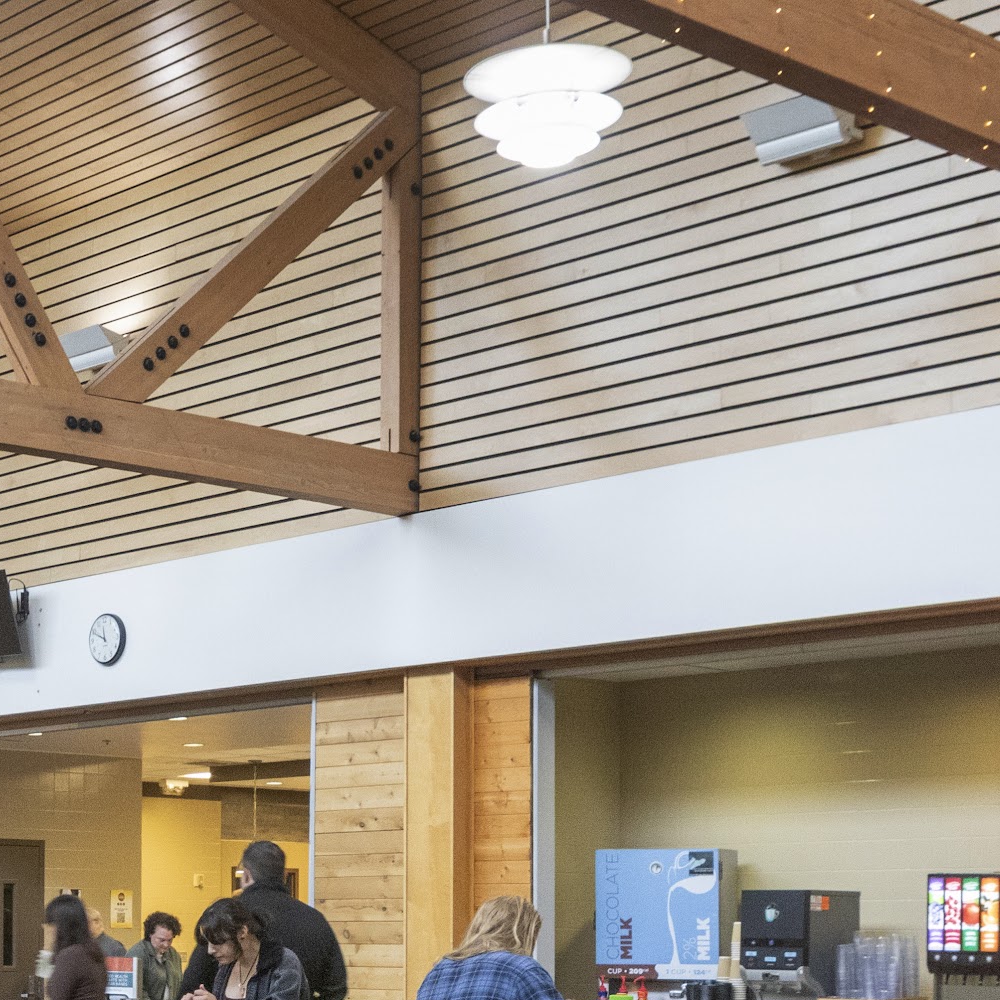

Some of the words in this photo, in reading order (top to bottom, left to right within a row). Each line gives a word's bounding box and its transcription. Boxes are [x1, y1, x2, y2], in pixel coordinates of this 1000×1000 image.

[605, 853, 620, 960] CHOCOLATE
[620, 917, 633, 959] MILK
[684, 937, 697, 960] 2%
[697, 918, 710, 960] MILK
